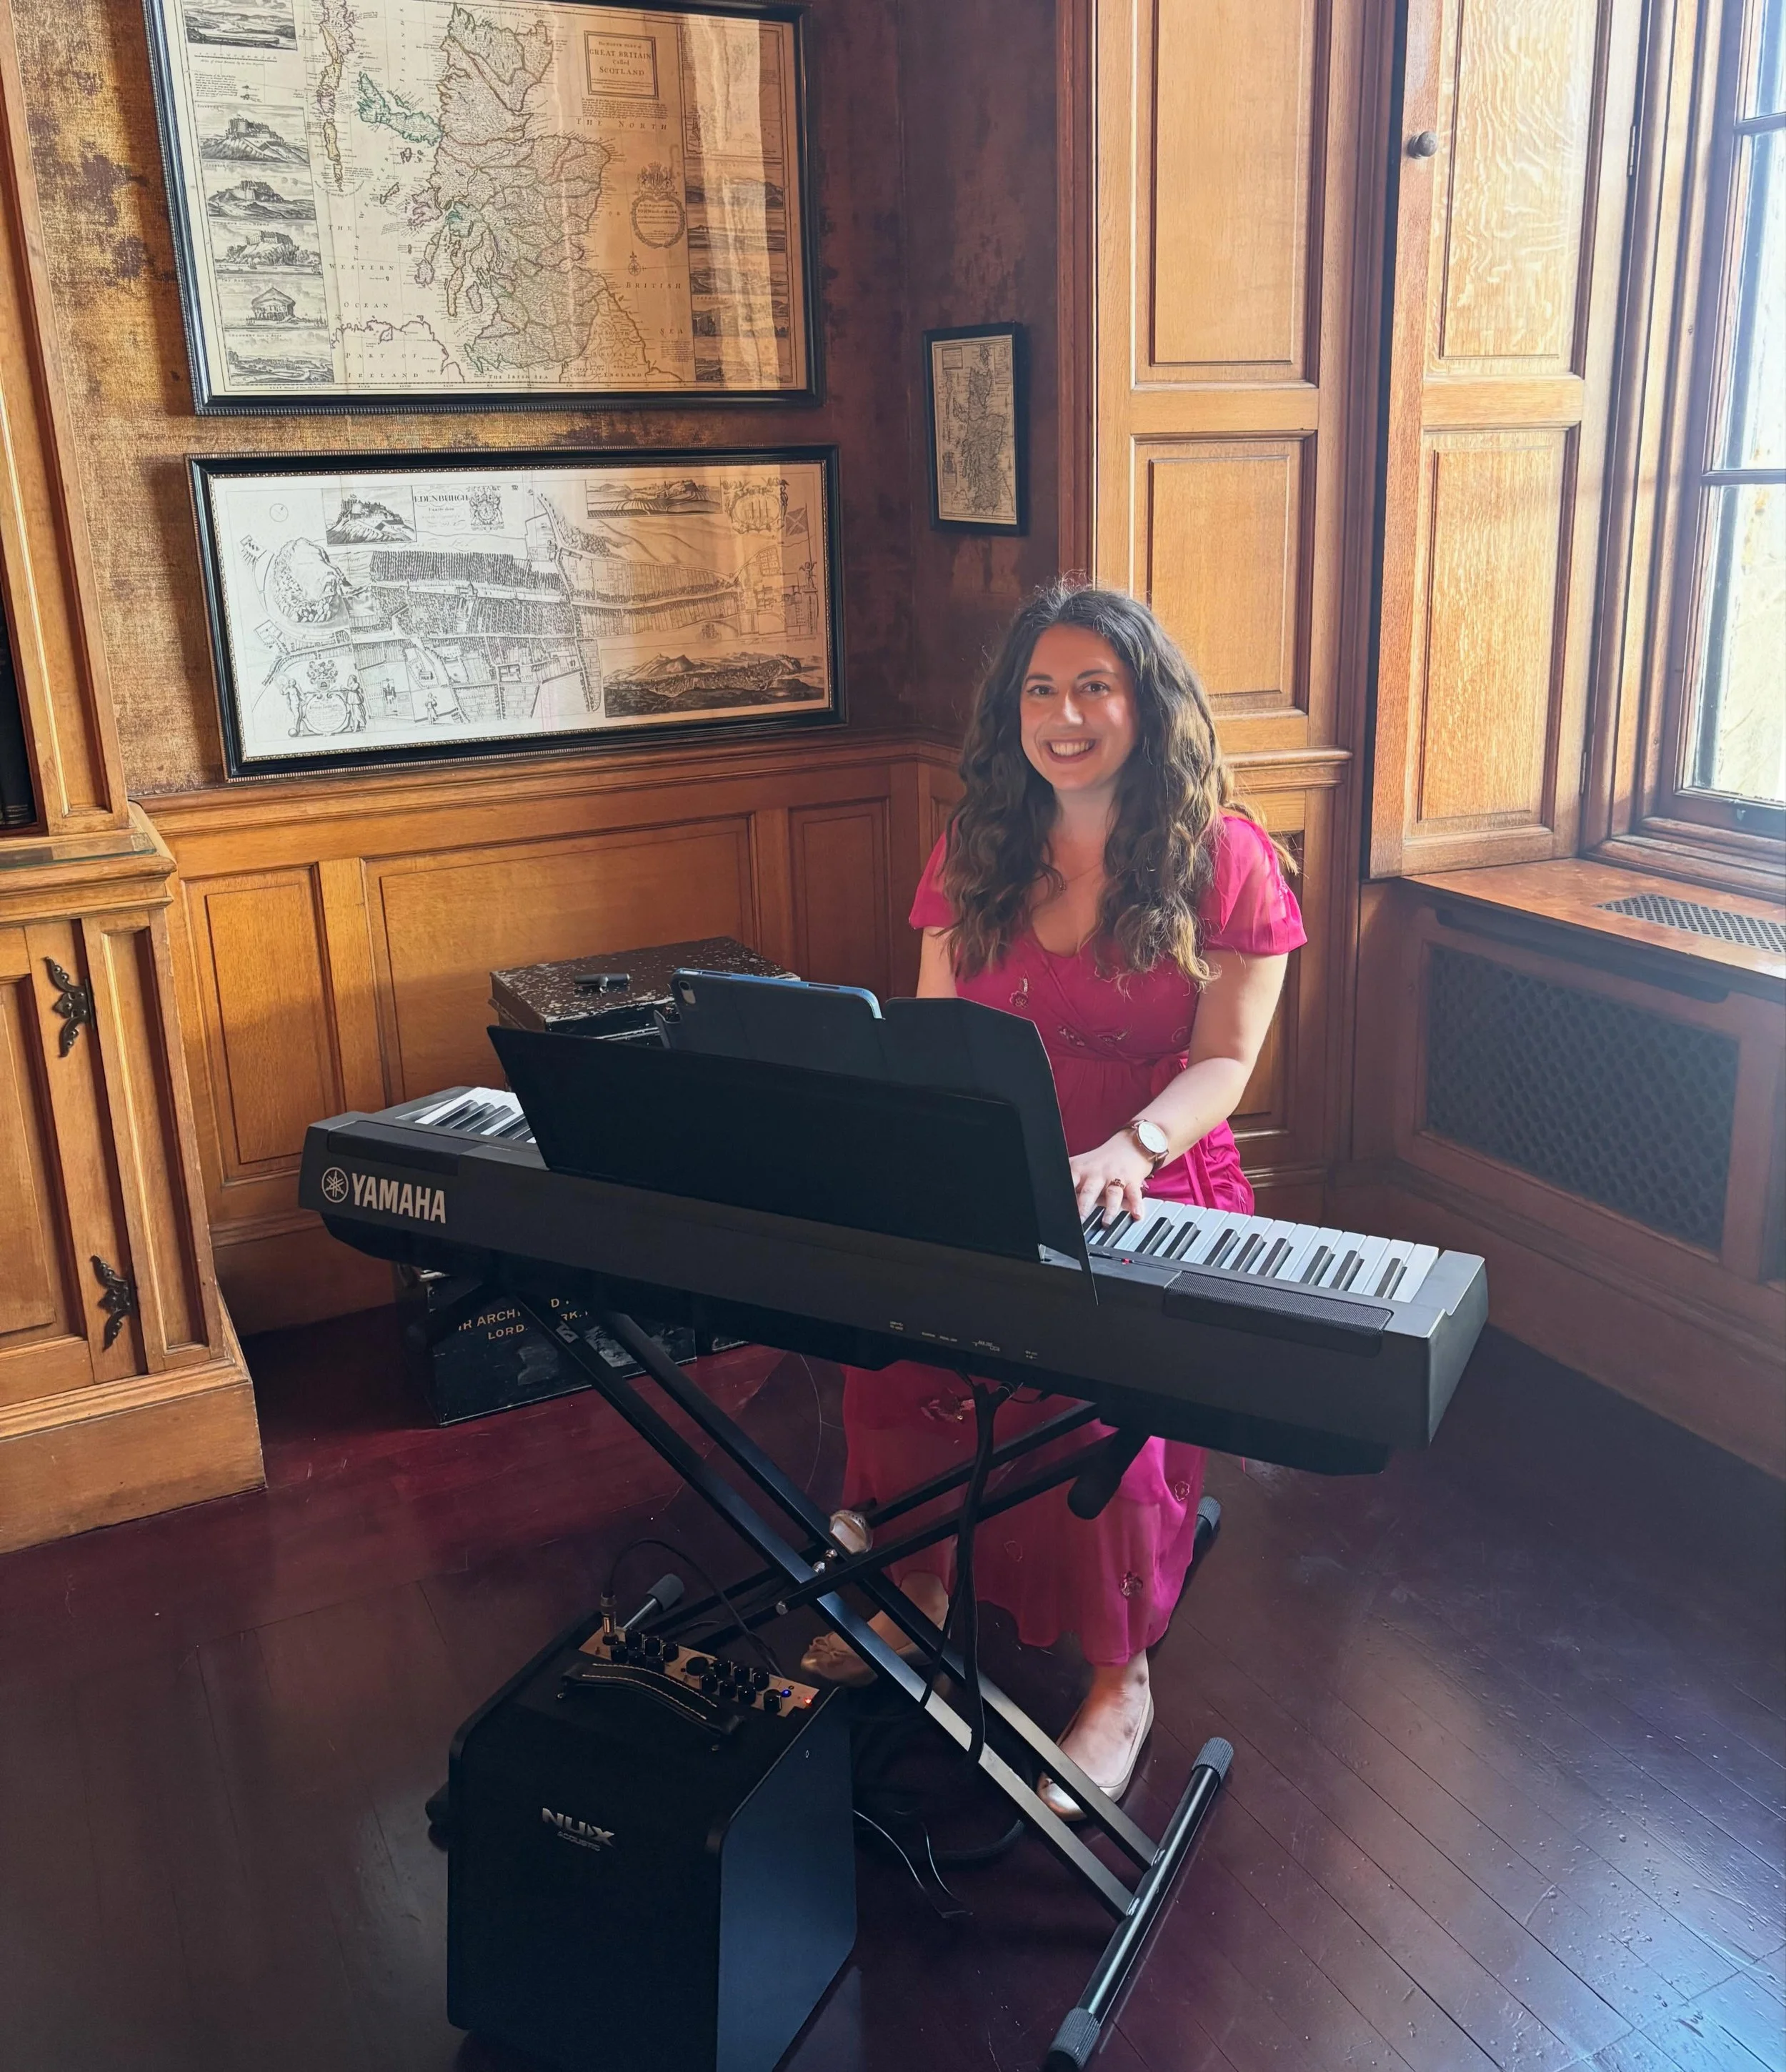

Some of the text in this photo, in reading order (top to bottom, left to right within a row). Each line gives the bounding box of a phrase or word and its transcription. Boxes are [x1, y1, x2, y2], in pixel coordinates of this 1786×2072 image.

[619, 51, 652, 59] BRITAIN
[599, 66, 644, 76] SCOTLAND
[576, 118, 667, 130] THE NORTH
[352, 1172, 446, 1224] YAMAHA
[542, 1807, 615, 1848] NUX
